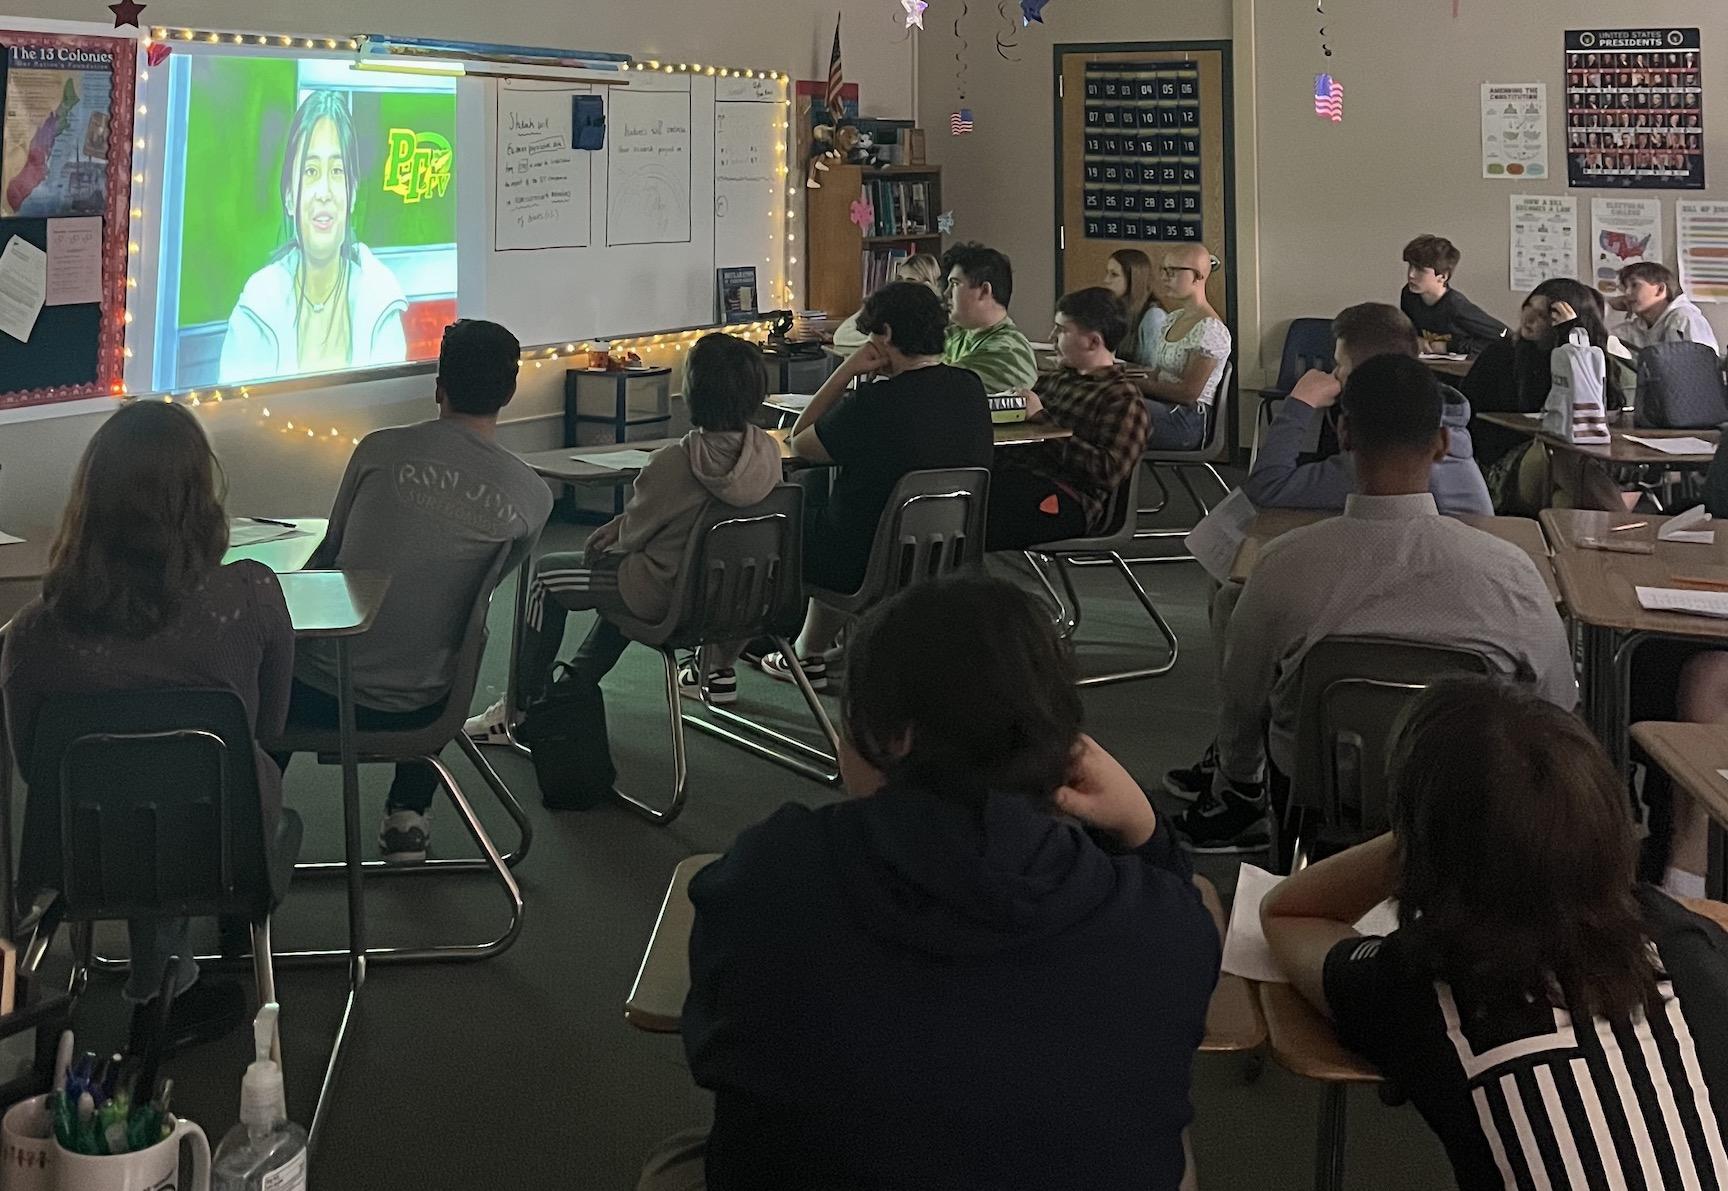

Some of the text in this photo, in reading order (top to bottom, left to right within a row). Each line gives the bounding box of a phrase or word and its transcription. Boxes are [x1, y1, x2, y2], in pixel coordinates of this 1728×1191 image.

[1631, 31, 1662, 39] STATES
[1599, 38, 1663, 47] PRESIDENTS
[10, 46, 114, 63] The 13 Colonies
[1088, 85, 1097, 94] 01
[1106, 85, 1115, 94] 02
[1142, 85, 1152, 94] 04
[1163, 84, 1173, 94] 05
[1182, 84, 1192, 93] 06
[1089, 112, 1098, 121] 07
[1143, 113, 1153, 122] 10
[1164, 113, 1173, 122] 11
[1183, 112, 1193, 121] 12
[1088, 140, 1098, 149] 13
[1106, 141, 1115, 149] 14
[1125, 141, 1134, 150] 15
[1142, 142, 1152, 151] 16
[1164, 141, 1173, 150] 17
[1088, 167, 1097, 177] 19
[1106, 168, 1116, 177] 20
[1144, 170, 1154, 179] 22
[1164, 169, 1174, 178] 23
[1184, 170, 1194, 179] 24
[1106, 196, 1116, 205] 26
[1125, 197, 1134, 206] 27
[1145, 198, 1155, 207] 28
[1164, 199, 1175, 208] 29
[1185, 198, 1194, 207] 30
[1107, 224, 1117, 233] 32
[1127, 225, 1136, 234] 33
[1147, 226, 1156, 235] 34
[1167, 226, 1177, 235] 35
[1184, 227, 1194, 236] 36
[400, 463, 459, 489] RON
